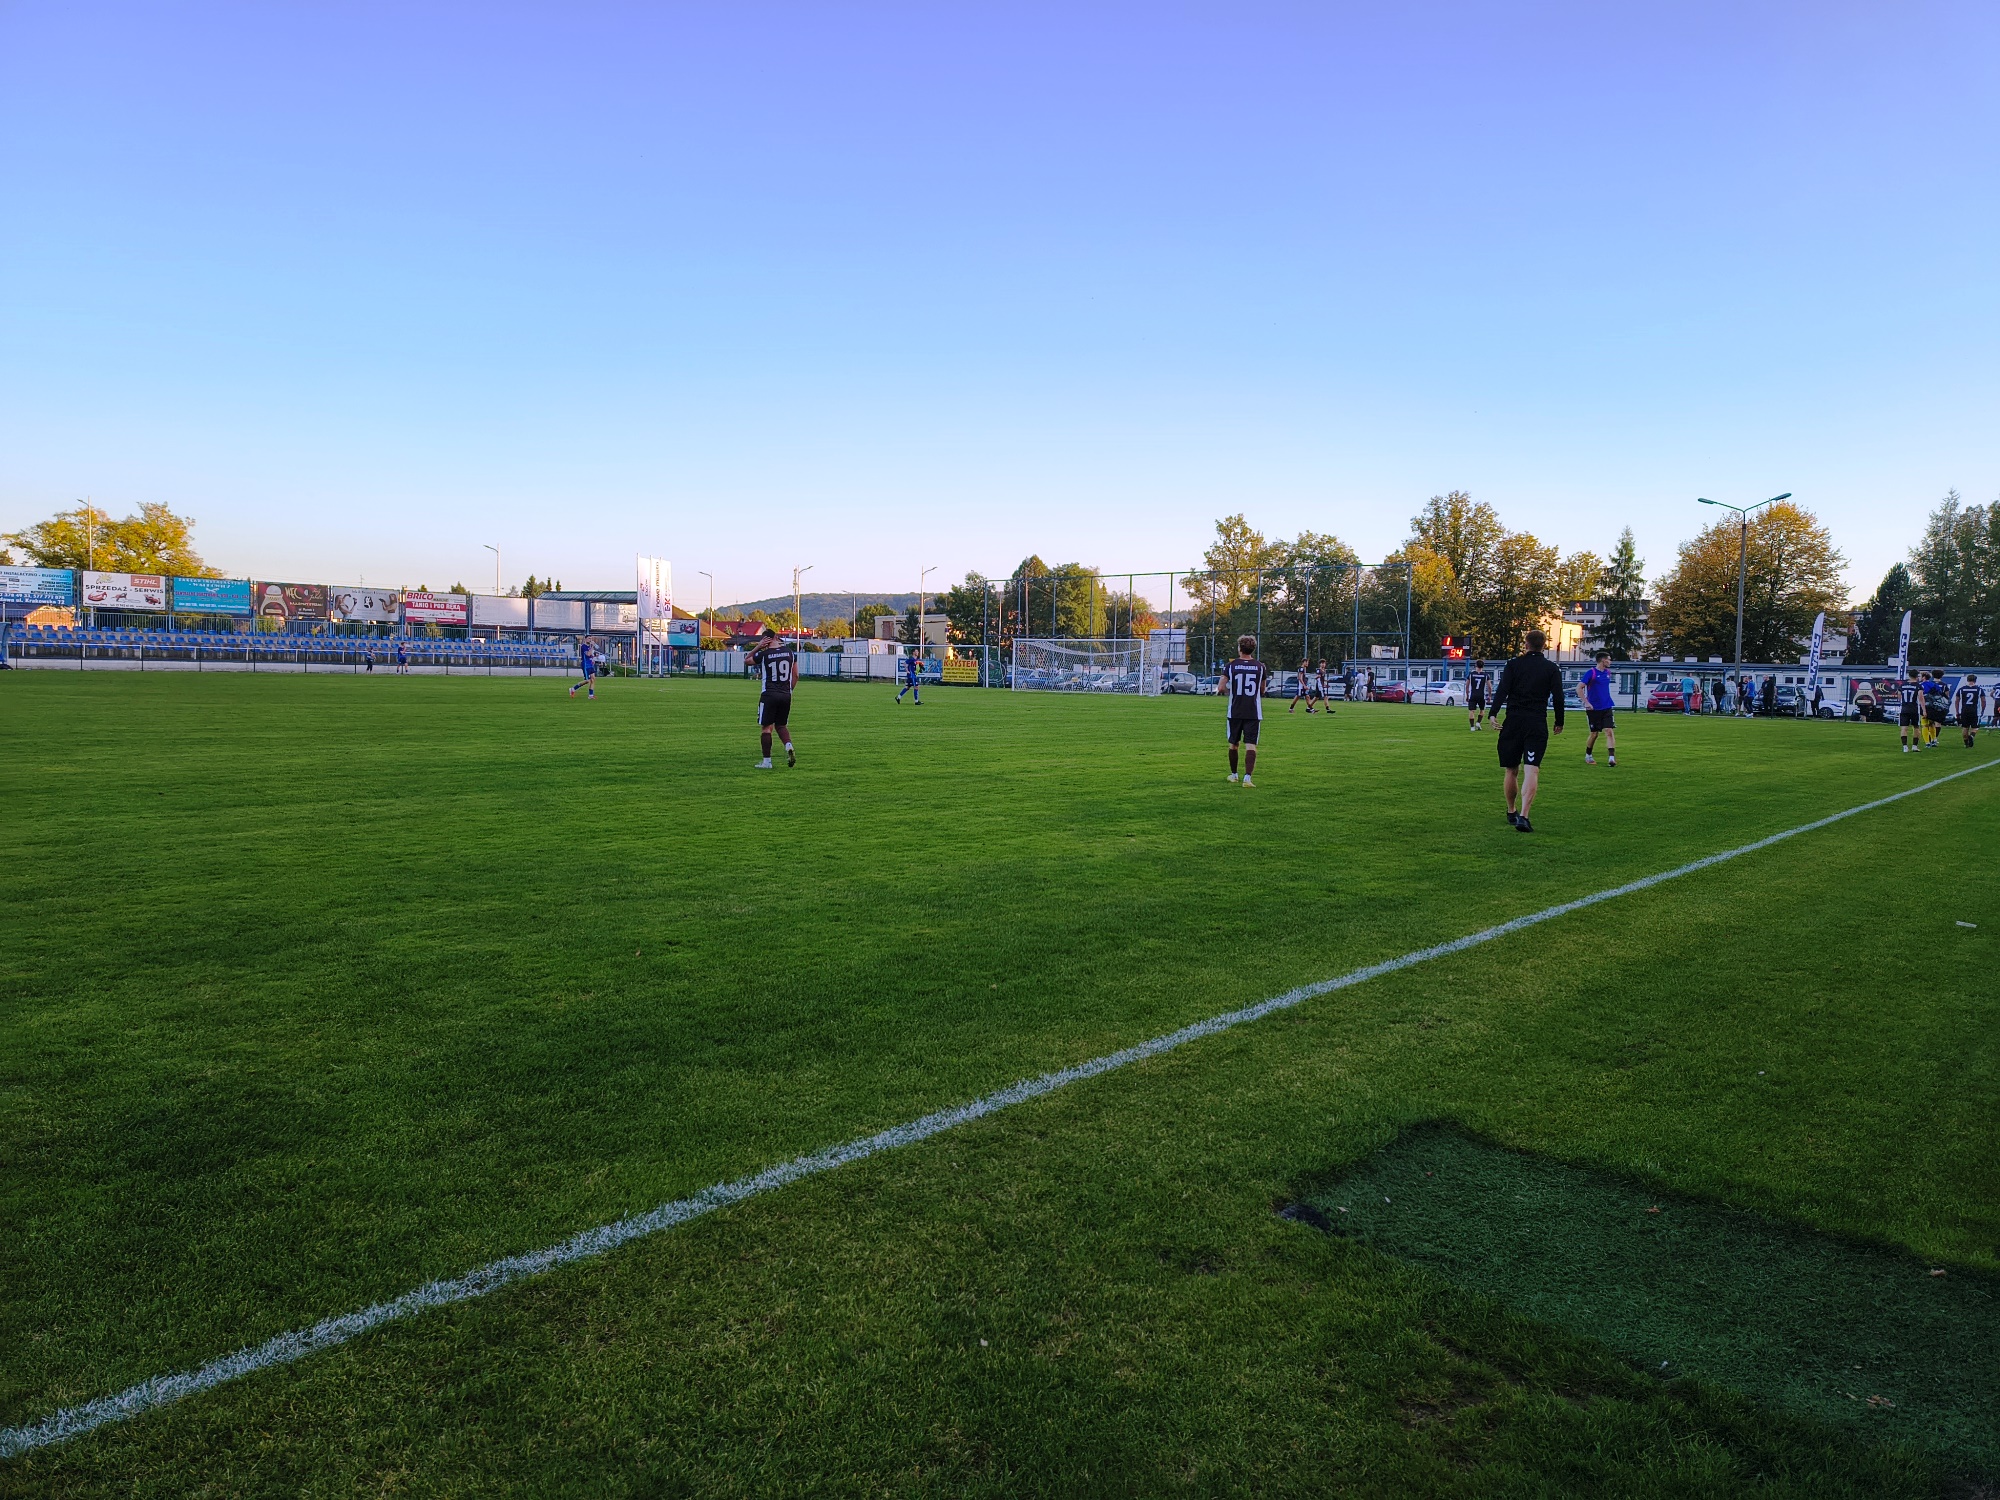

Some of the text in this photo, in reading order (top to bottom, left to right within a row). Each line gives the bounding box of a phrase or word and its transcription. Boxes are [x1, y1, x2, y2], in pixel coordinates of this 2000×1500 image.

[85, 584, 128, 592] SPRZEDAŻ
[406, 592, 434, 600] BRICO
[943, 660, 977, 668] K-SYSTEM
[768, 659, 790, 682] 19
[1234, 673, 1257, 697] 15
[1475, 678, 1482, 690] 7
[1902, 689, 1916, 703] 17
[1965, 692, 1974, 705] 2
